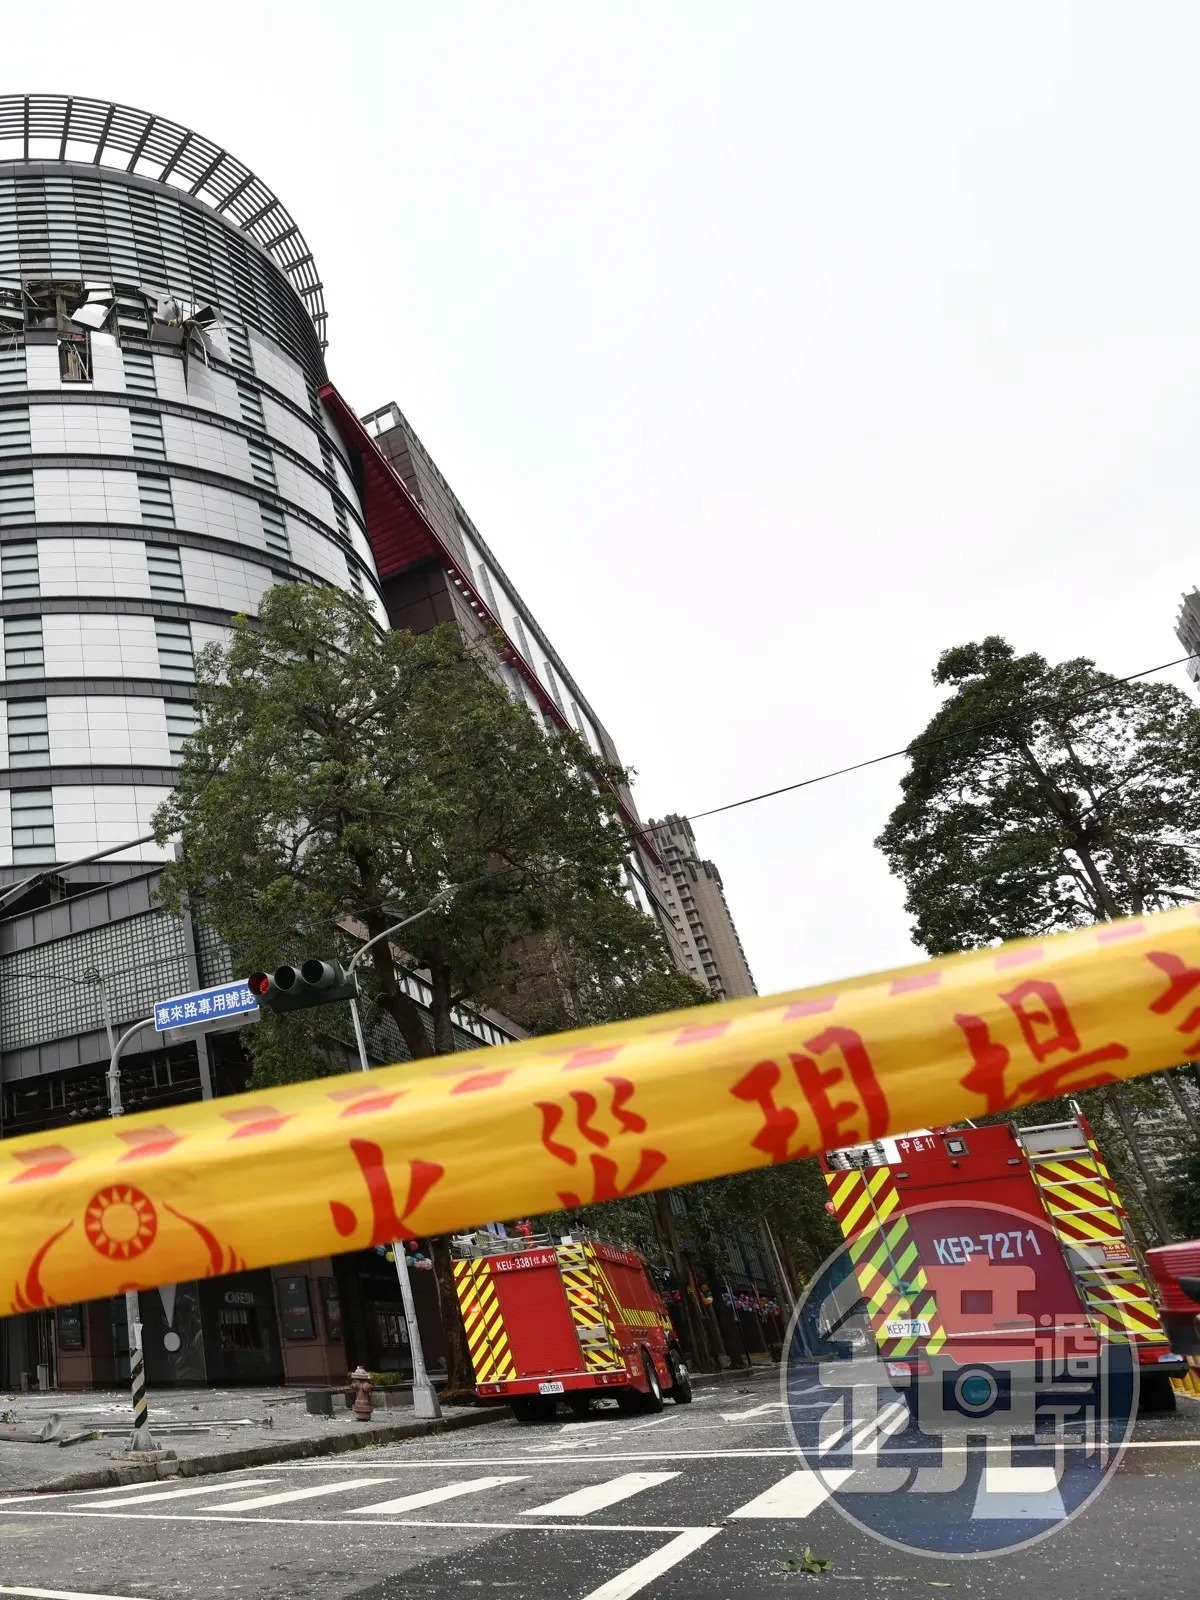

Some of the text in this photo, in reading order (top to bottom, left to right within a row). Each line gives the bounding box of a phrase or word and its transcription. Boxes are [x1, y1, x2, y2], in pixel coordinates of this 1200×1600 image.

[157, 989, 256, 1025] 惠來路專用號誌
[900, 1137, 935, 1153] 中區11
[933, 1229, 1041, 1264] KEP-7271
[496, 1256, 534, 1271] KEU-3381
[886, 1322, 928, 1335] KEP-7271
